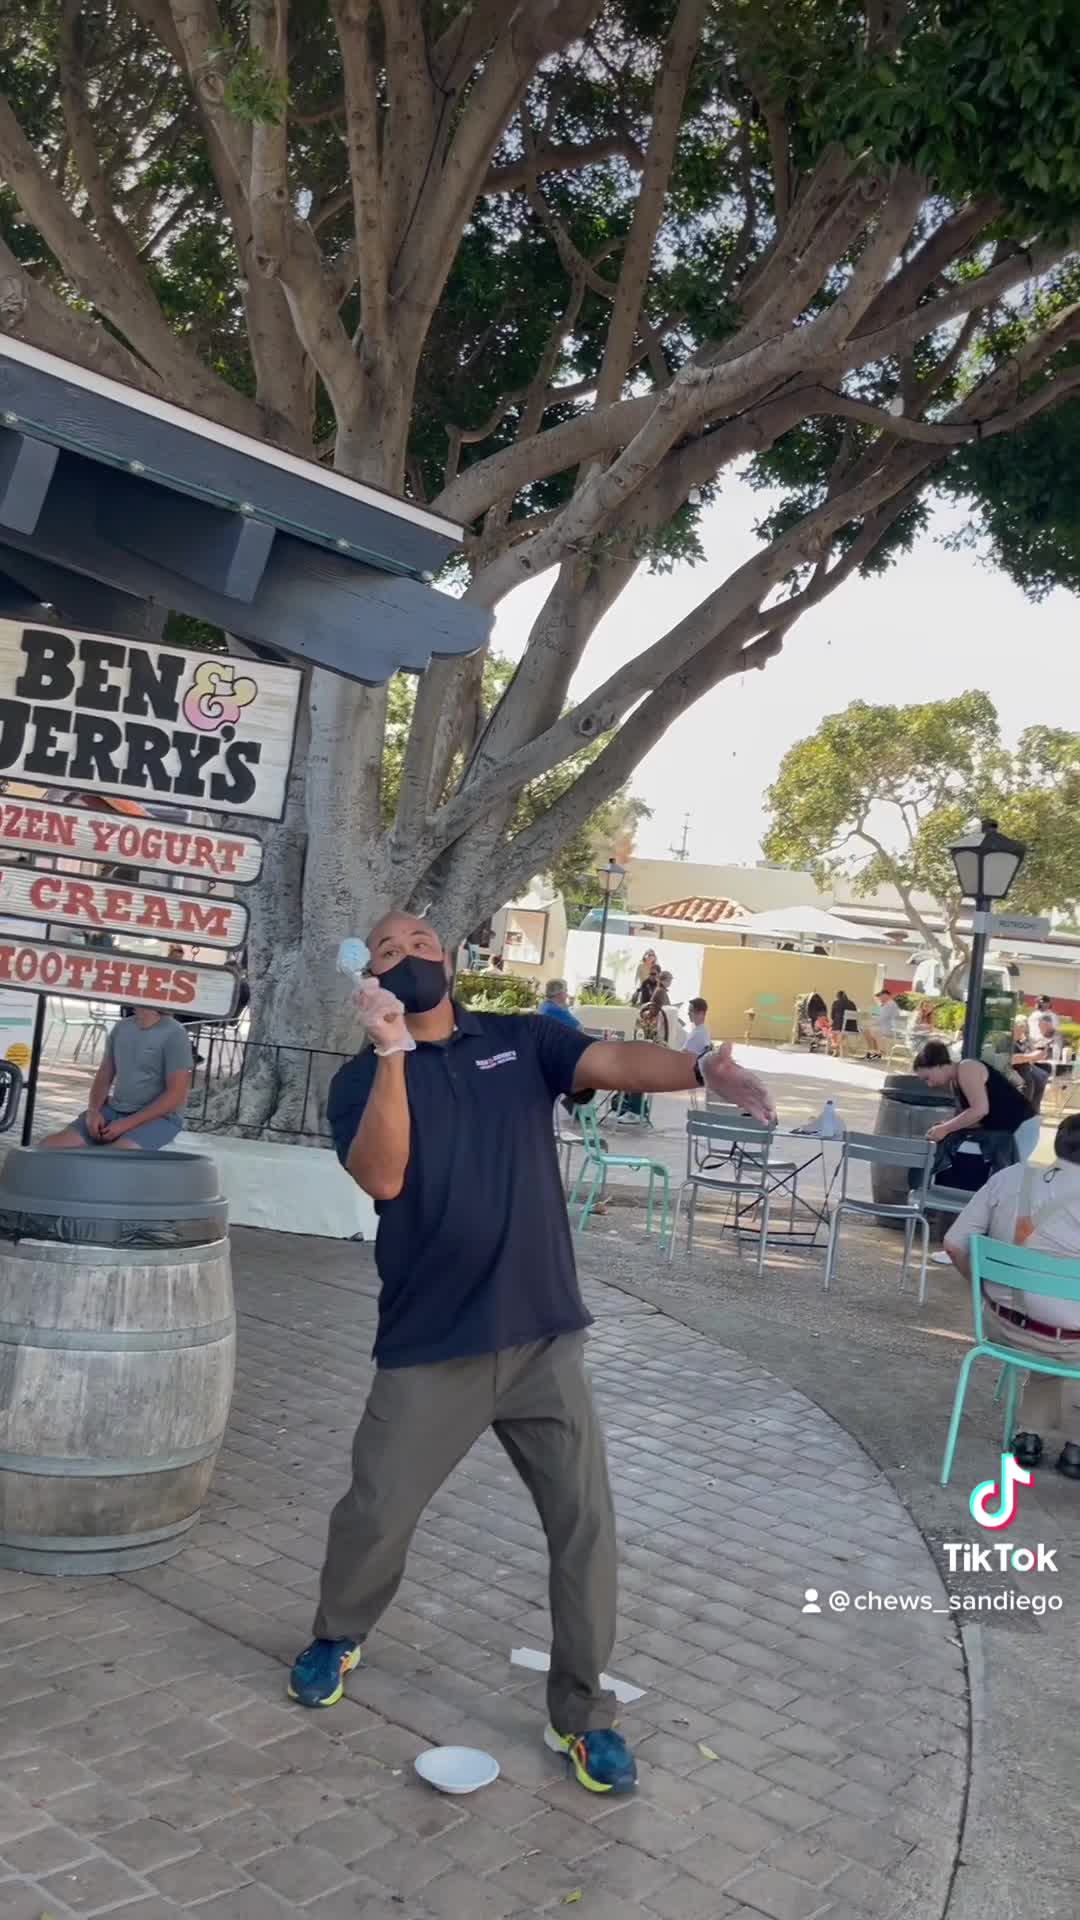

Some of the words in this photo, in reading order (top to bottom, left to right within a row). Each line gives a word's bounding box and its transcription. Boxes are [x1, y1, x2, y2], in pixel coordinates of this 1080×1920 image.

[16, 629, 186, 722] BEN
[182, 661, 258, 731] &
[0, 698, 262, 804] JERRY'S
[0, 803, 78, 847] ZEN
[88, 820, 245, 875] YOGURT
[29, 876, 232, 938] CREAM
